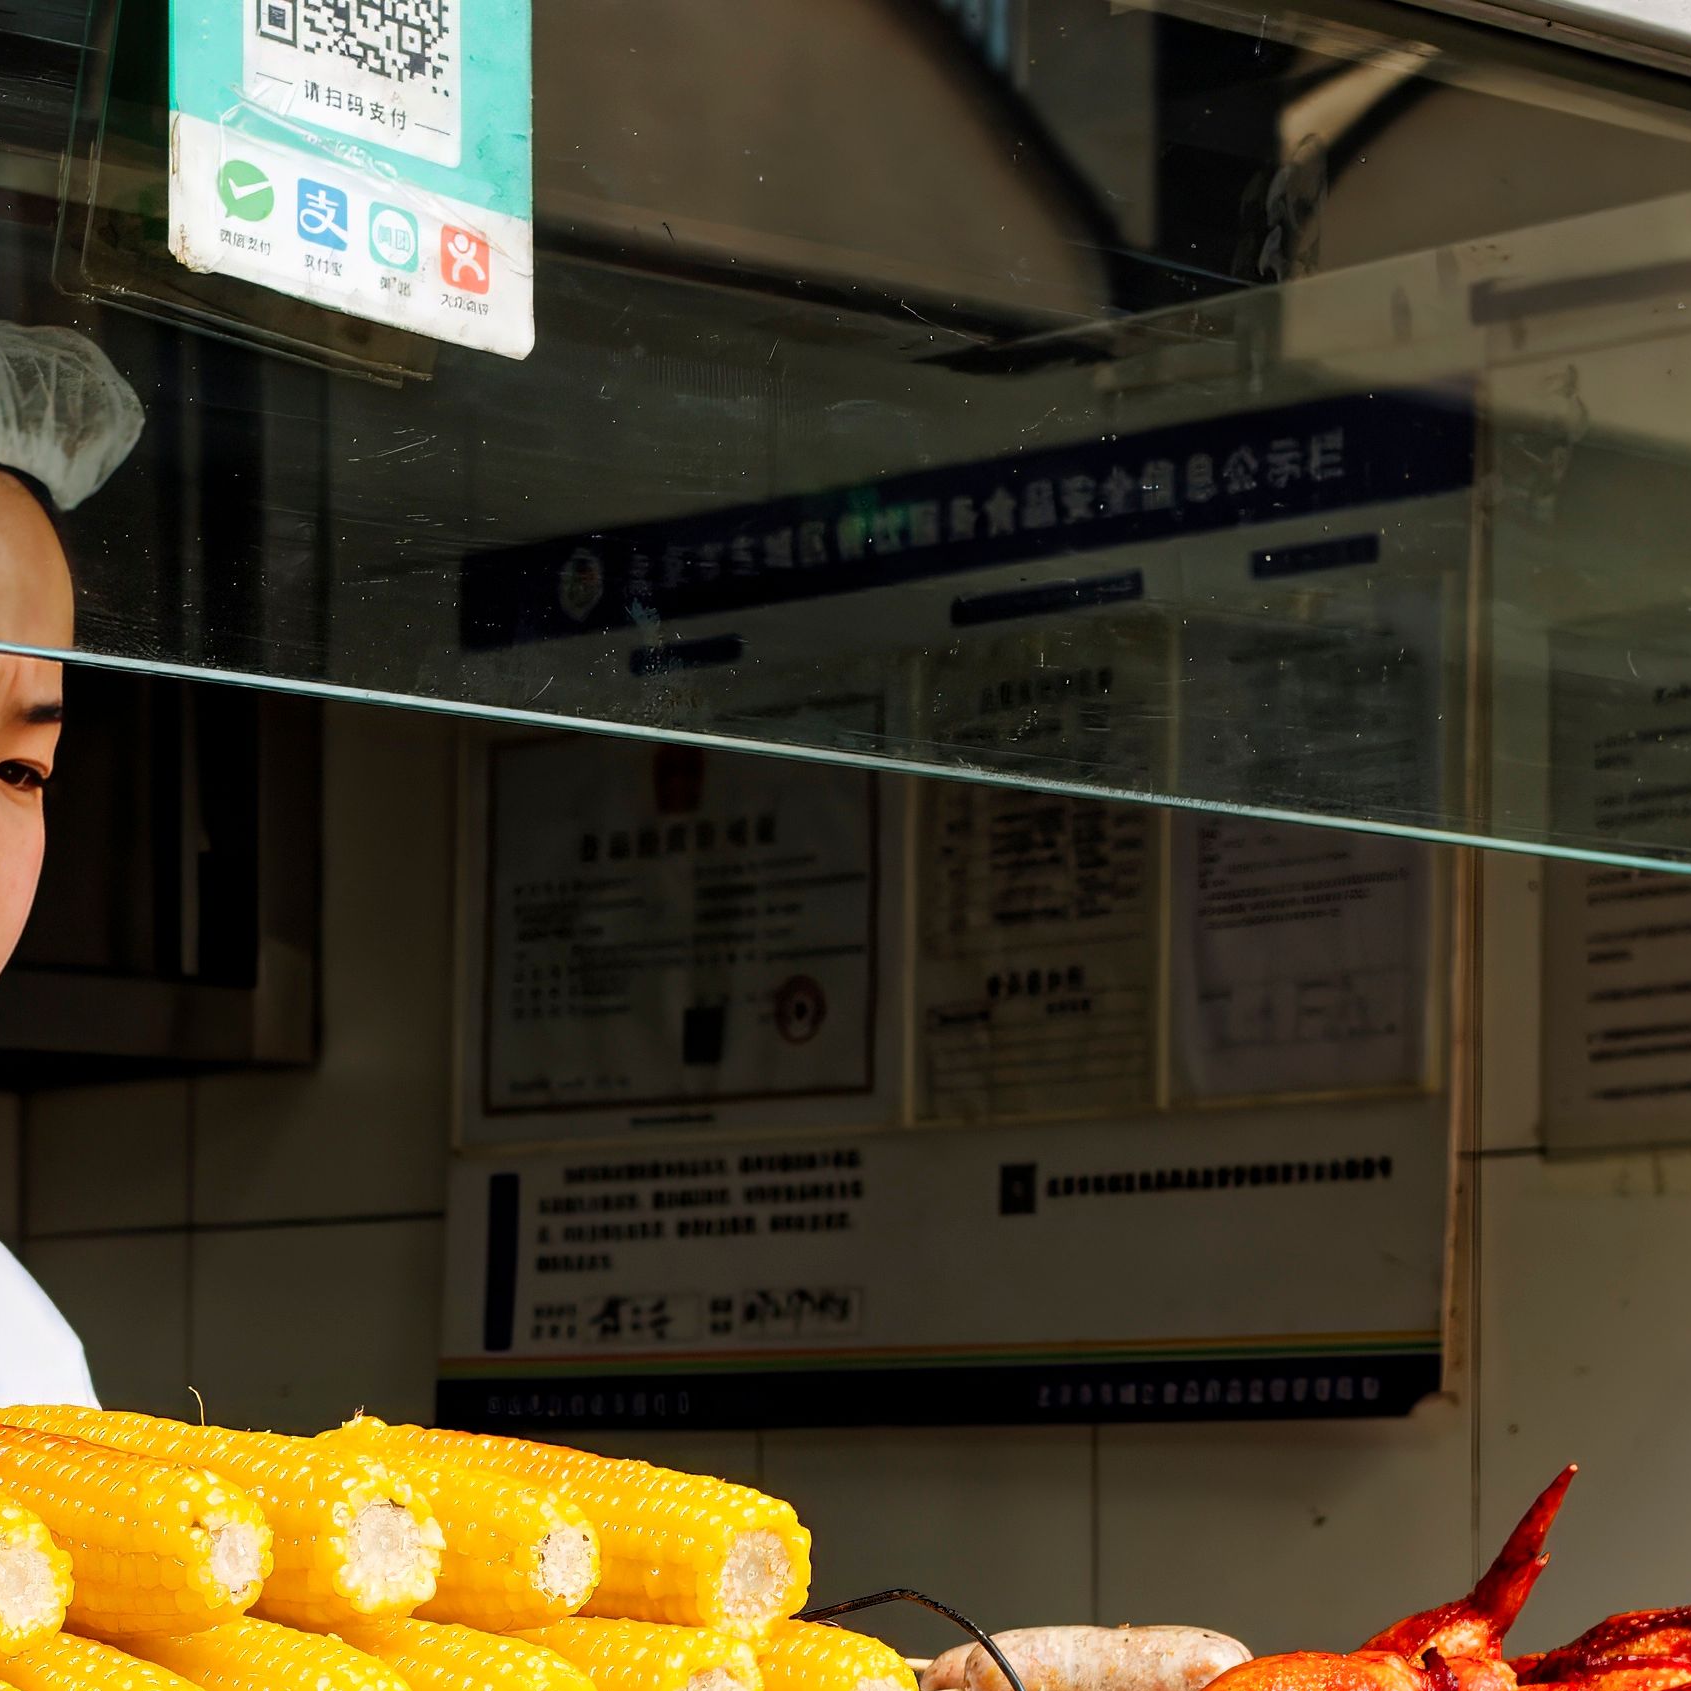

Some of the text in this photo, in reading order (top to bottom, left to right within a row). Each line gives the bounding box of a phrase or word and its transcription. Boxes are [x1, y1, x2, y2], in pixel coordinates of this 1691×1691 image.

[304, 79, 407, 131] 请扫码支付
